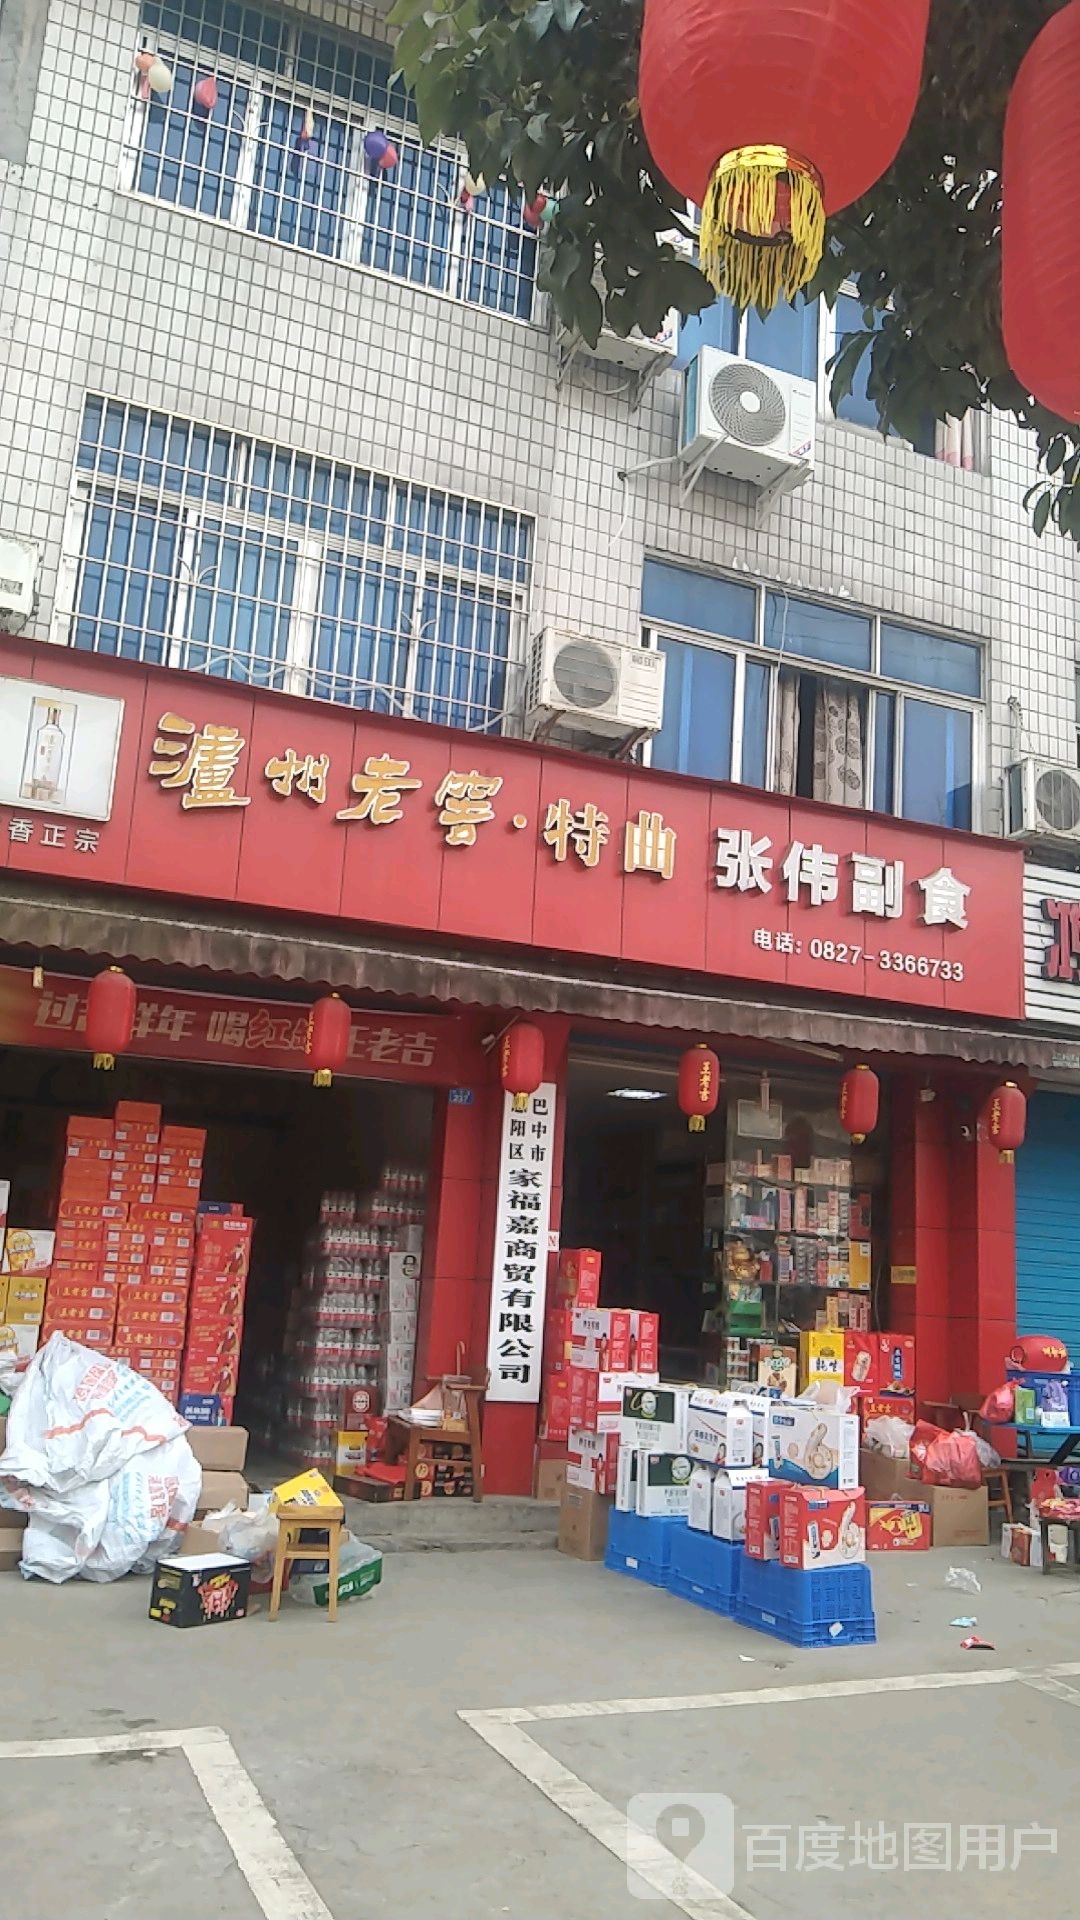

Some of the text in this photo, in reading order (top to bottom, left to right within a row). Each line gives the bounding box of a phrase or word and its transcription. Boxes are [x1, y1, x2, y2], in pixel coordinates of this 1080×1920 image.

[7, 817, 100, 853] 香正宗
[713, 826, 972, 931] 张伟副食
[531, 1097, 548, 1162] 巴中市
[498, 1167, 544, 1385] 家福嘉商贸有限公司
